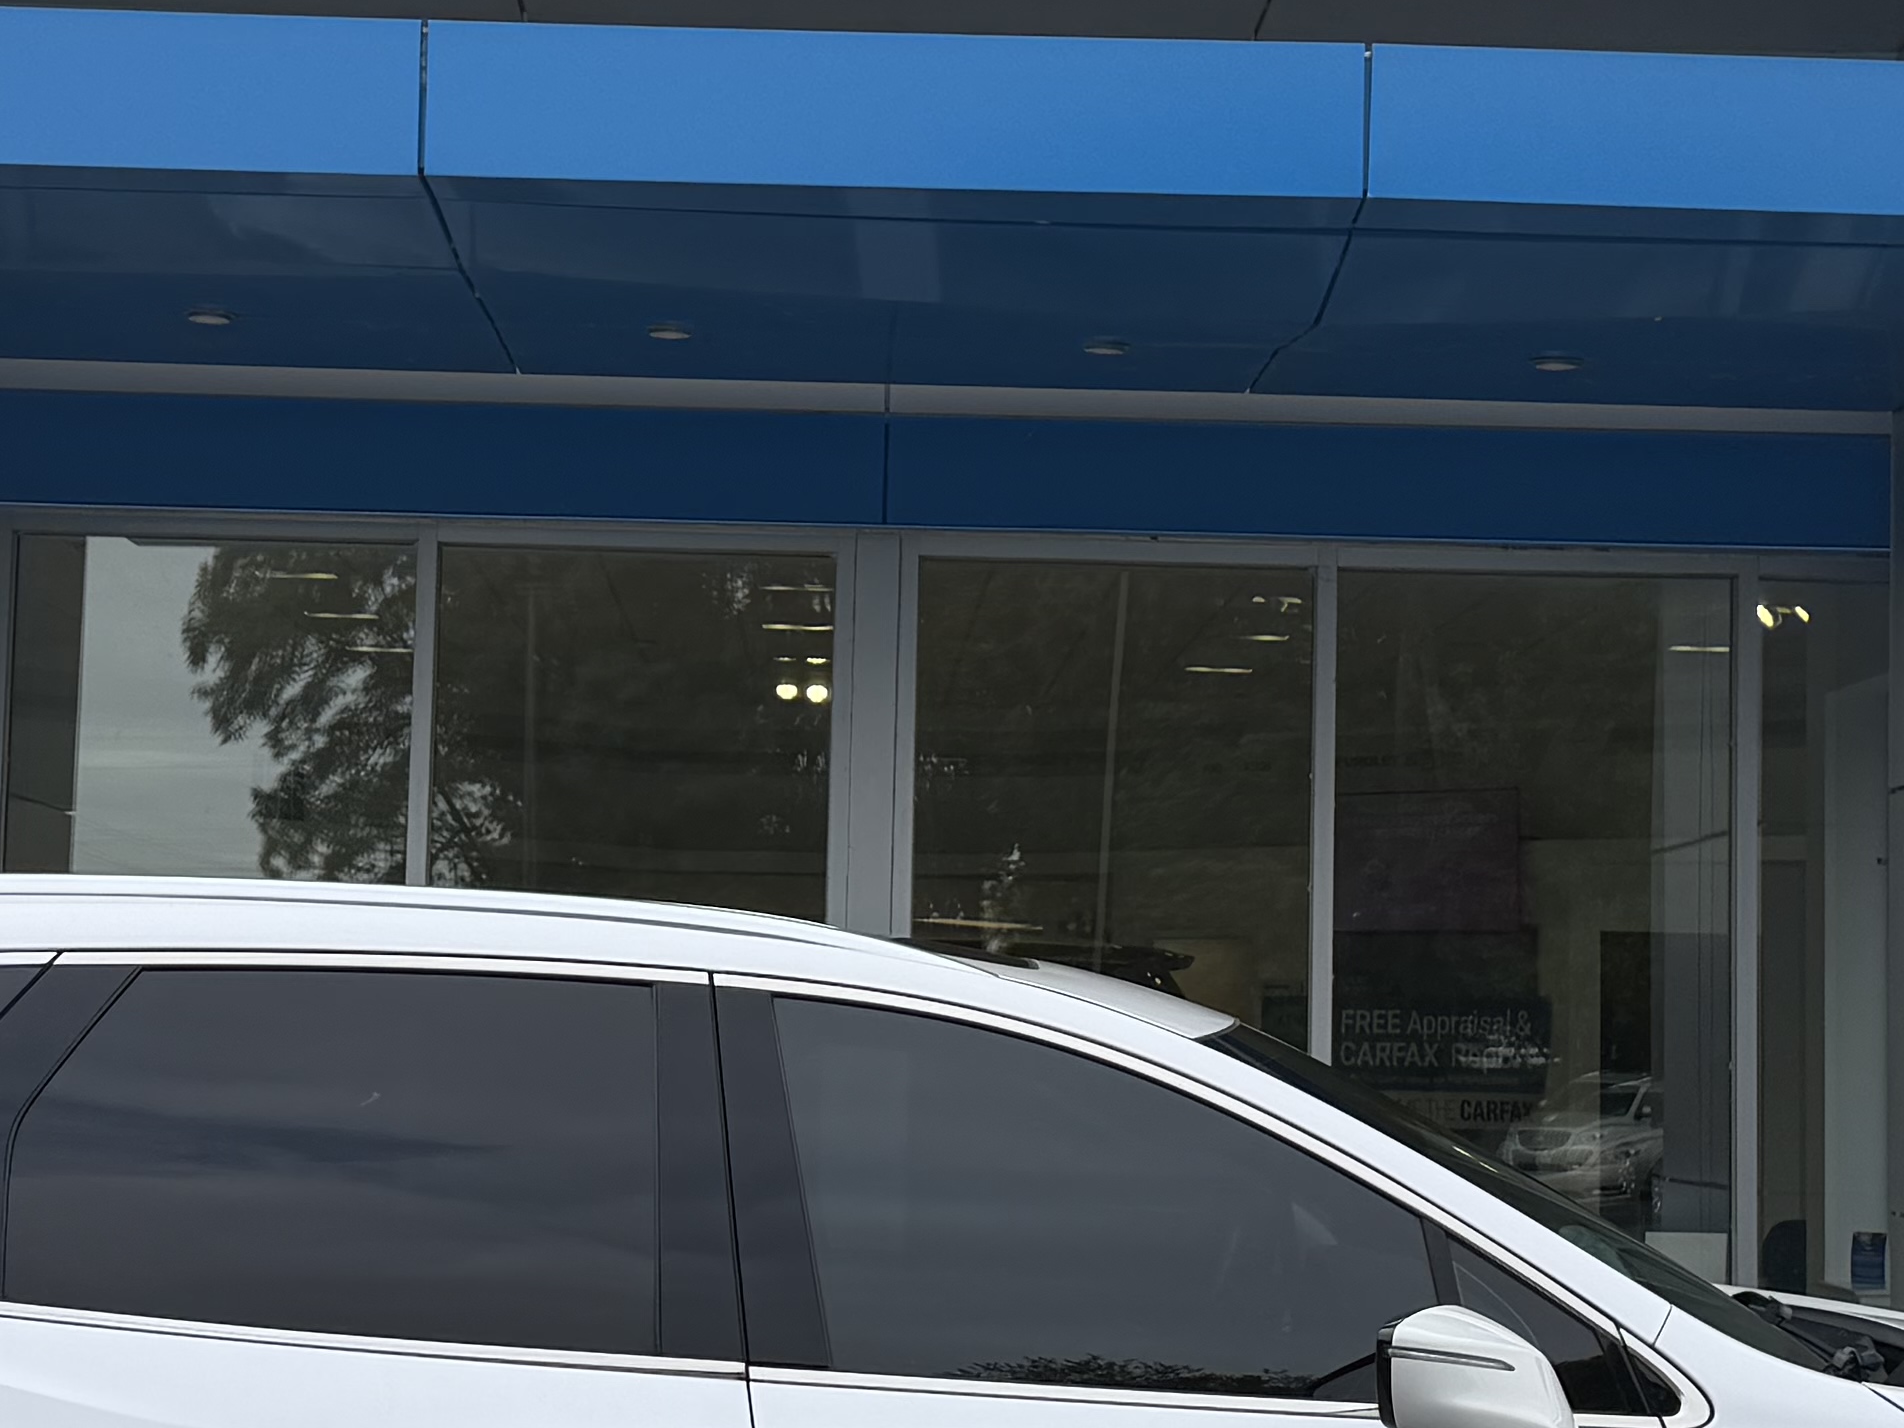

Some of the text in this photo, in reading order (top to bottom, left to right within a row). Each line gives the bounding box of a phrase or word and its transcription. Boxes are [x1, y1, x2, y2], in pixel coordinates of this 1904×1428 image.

[1340, 1007, 1532, 1041] FREE Appraisal &
[1339, 1041, 1440, 1068] CARFAX
[1460, 1098, 1533, 1123] CARFAX
